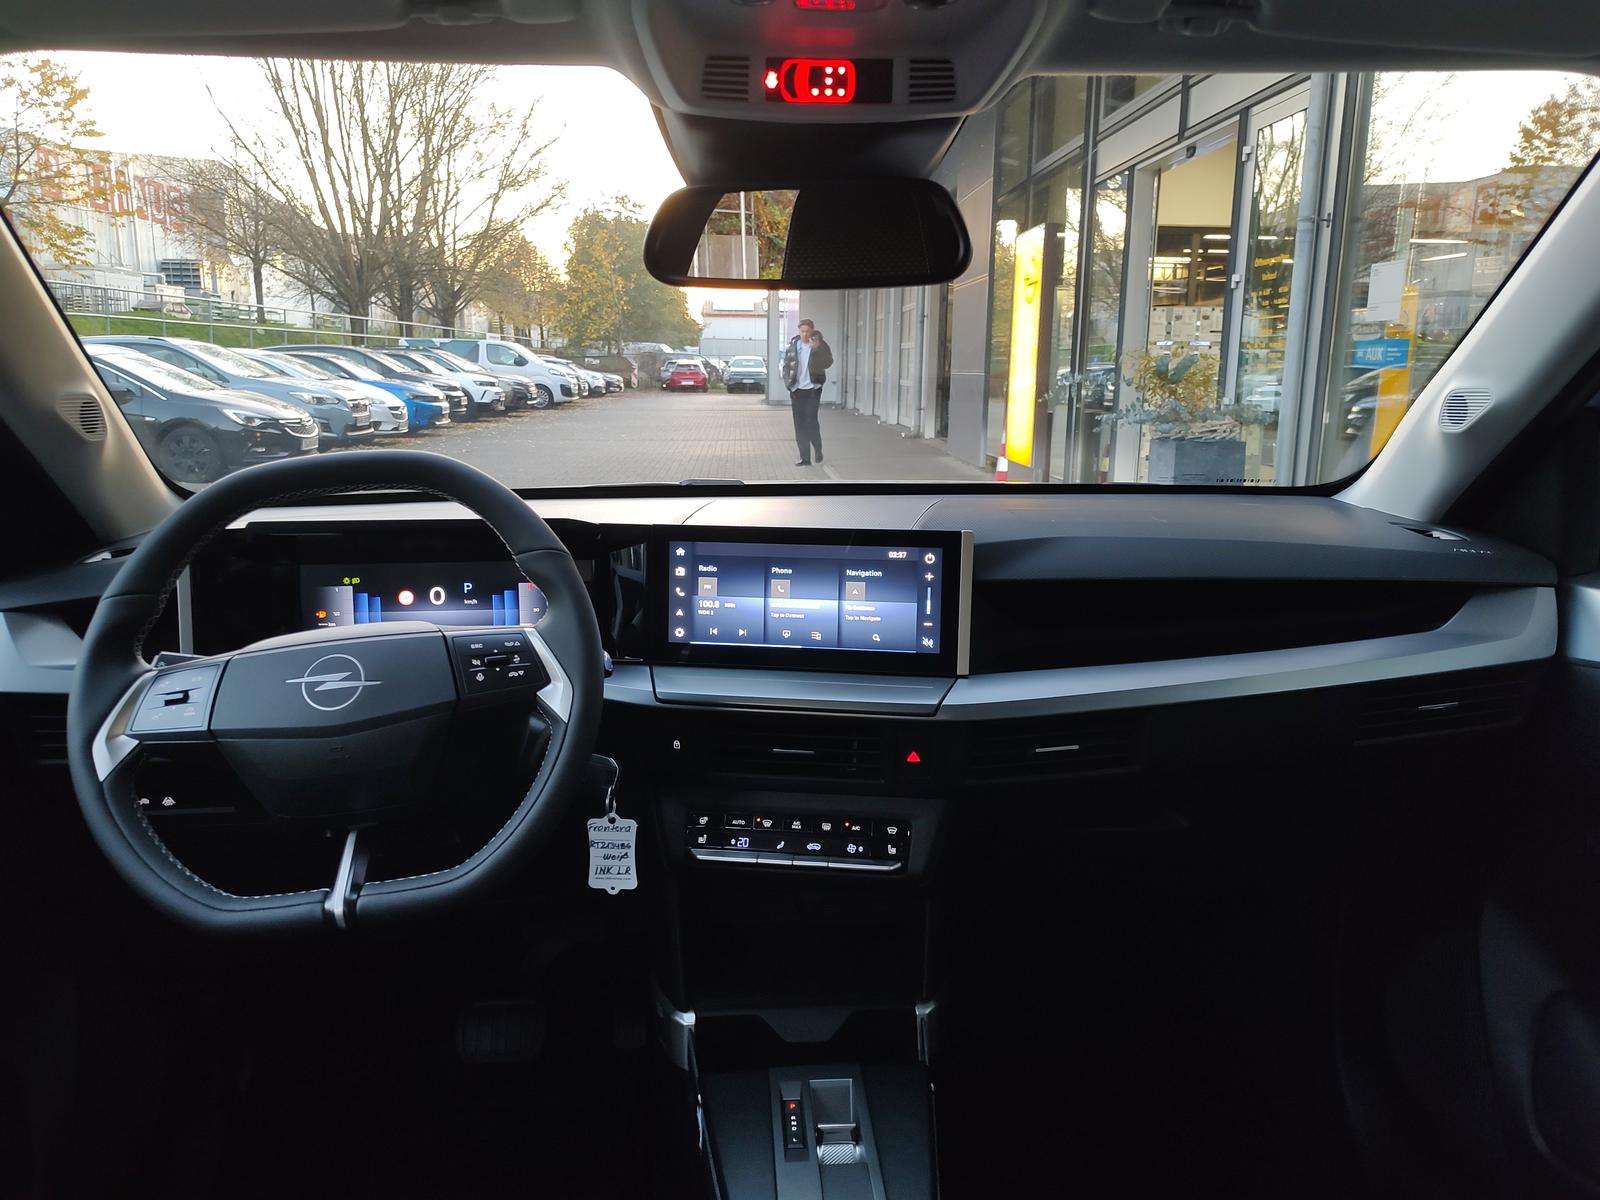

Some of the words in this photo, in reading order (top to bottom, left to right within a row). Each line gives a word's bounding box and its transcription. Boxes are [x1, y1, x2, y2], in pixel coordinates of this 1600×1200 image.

[698, 564, 718, 573] Radio
[771, 566, 793, 575] Phone
[846, 568, 883, 578] Navigation
[463, 582, 473, 594] P
[429, 586, 446, 606] 0
[737, 836, 750, 848] 20
